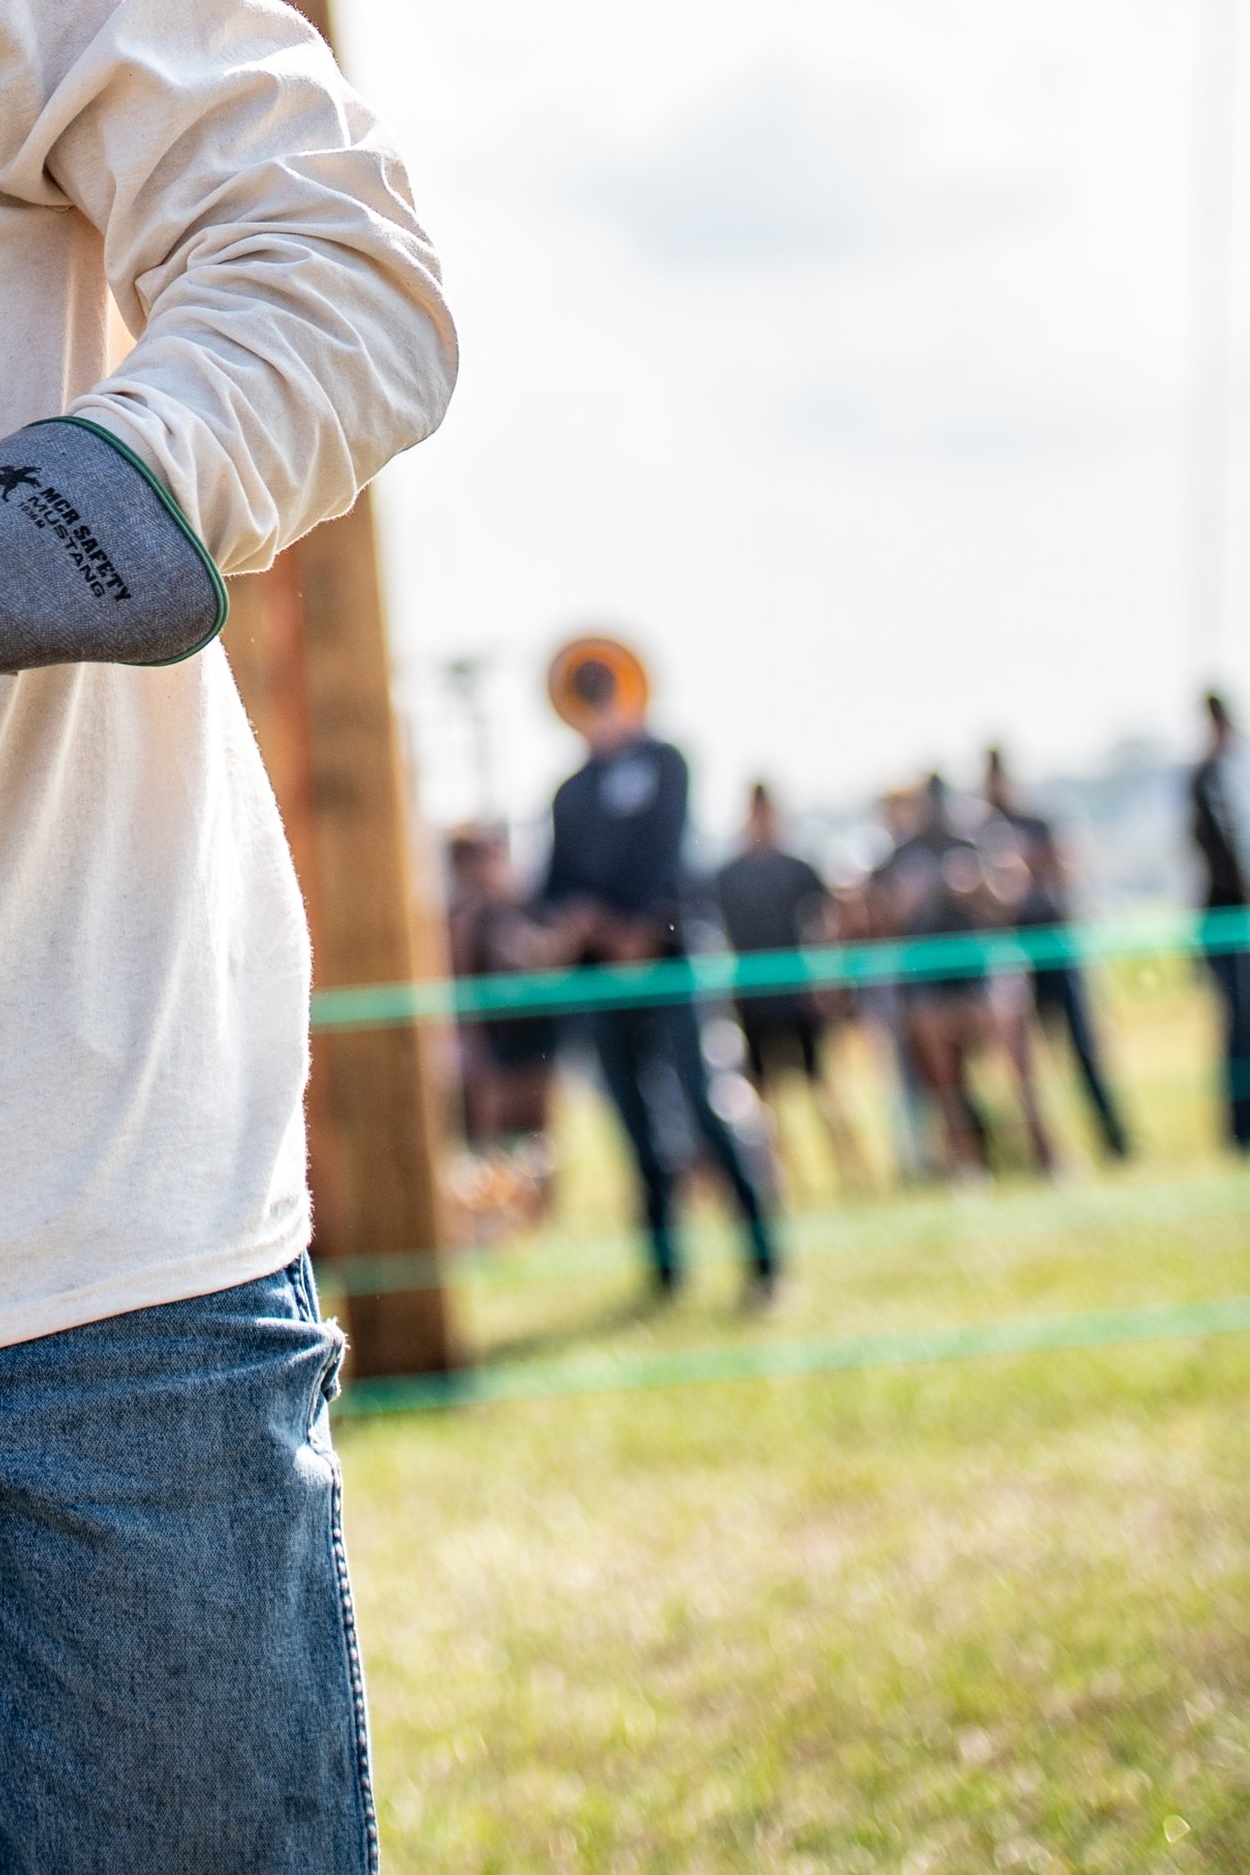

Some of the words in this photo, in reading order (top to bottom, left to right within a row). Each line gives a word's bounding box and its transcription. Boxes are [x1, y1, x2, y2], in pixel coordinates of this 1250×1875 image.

[27, 496, 105, 598] MUSTANG
[39, 487, 81, 525] MCR
[73, 525, 132, 602] SAFETY
